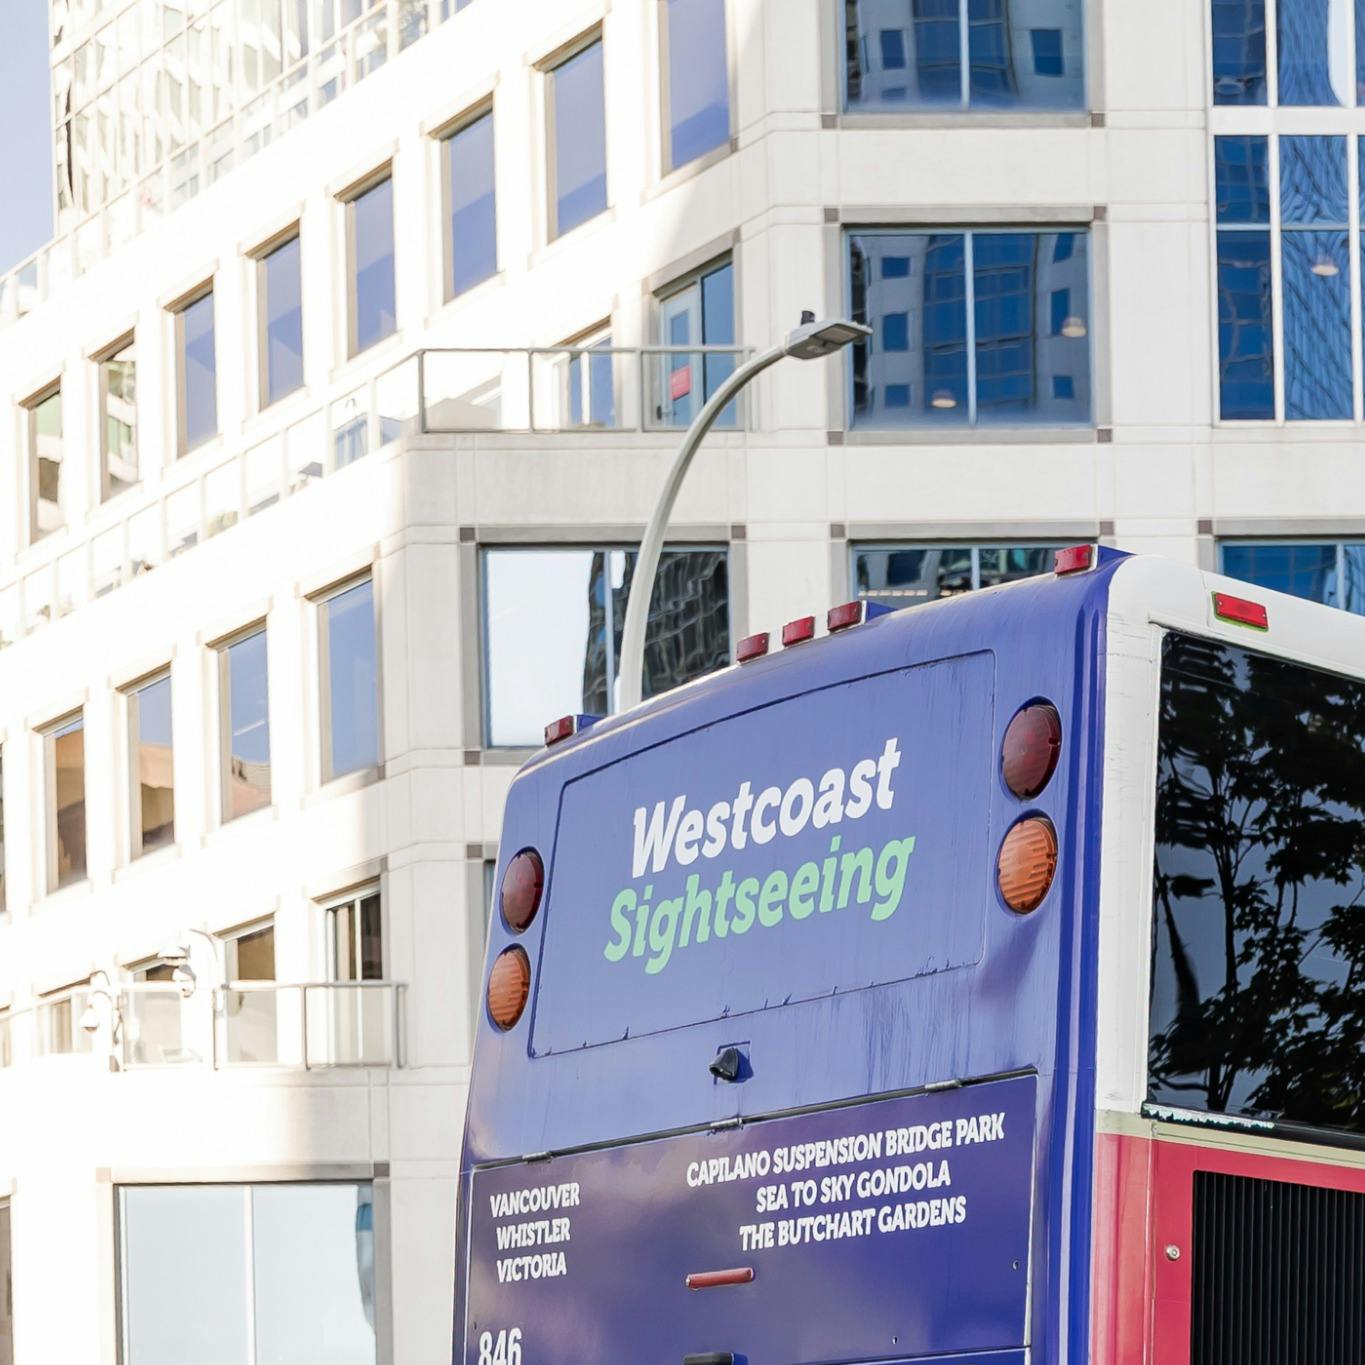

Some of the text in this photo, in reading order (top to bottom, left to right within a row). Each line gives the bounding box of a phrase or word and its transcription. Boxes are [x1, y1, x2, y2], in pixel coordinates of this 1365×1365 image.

[632, 737, 901, 878] Westcoast
[603, 834, 916, 974] Sightseeing
[686, 1112, 1006, 1188] CAPILANO SUSPENSION BRIDGE PARK
[490, 1182, 580, 1218] VANCOUVER
[755, 1159, 951, 1213] SEA TO SKY GONDOLA
[496, 1217, 571, 1250] WHISTLER
[739, 1195, 967, 1252] THE BUTCHART GARDENS
[496, 1251, 567, 1283] VICTORIA
